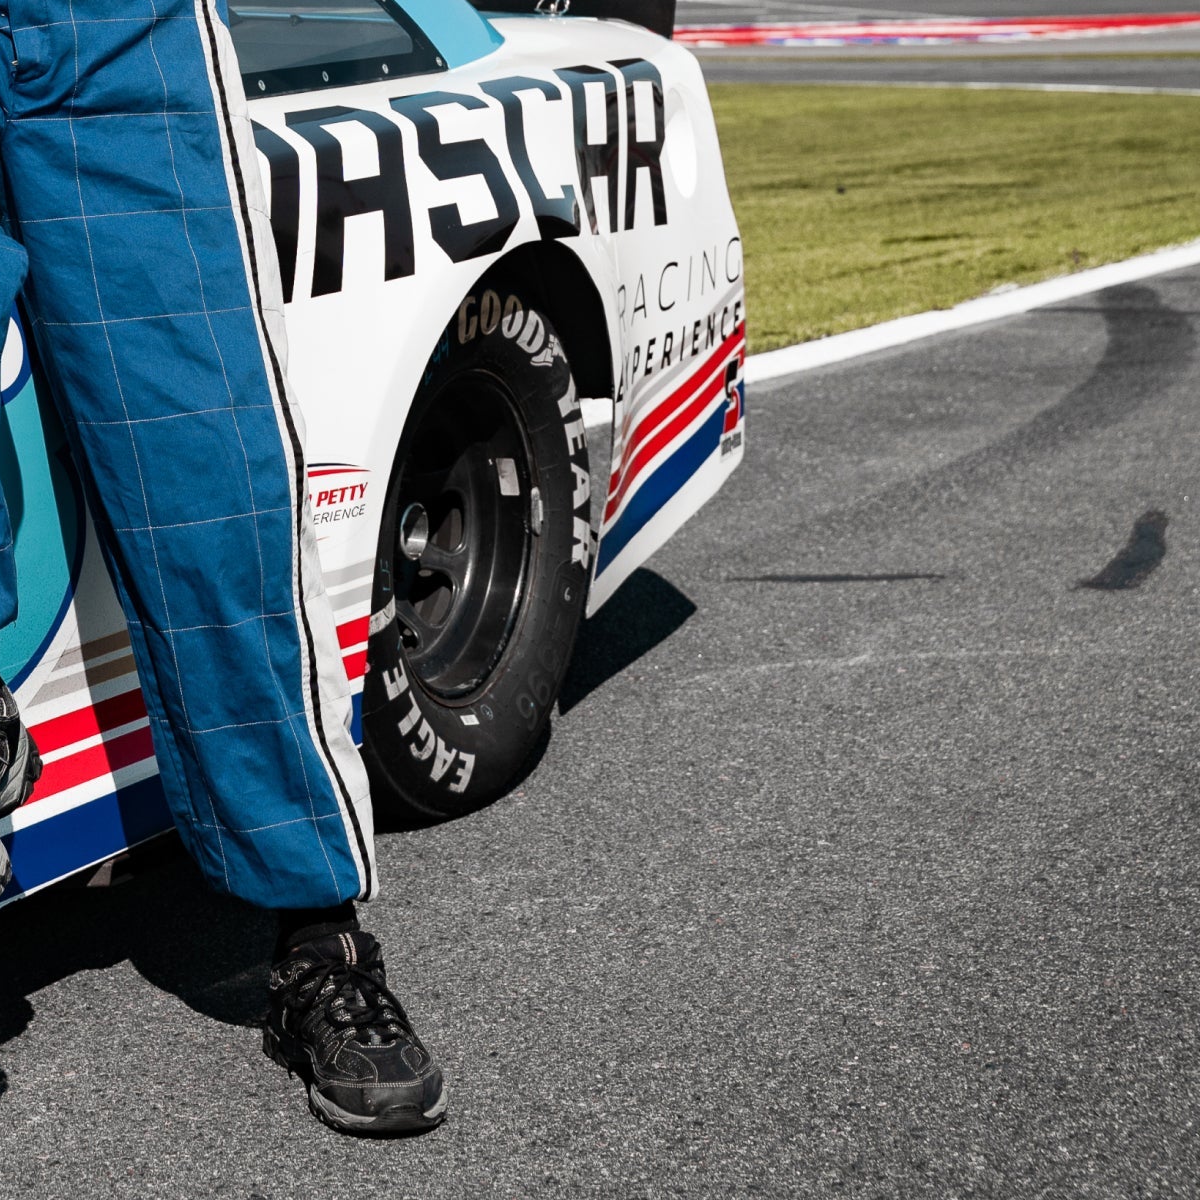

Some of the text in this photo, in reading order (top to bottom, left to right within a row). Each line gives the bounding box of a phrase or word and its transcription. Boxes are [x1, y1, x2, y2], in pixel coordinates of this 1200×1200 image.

[617, 237, 741, 332] RACING
[313, 504, 366, 525] ERIENCE
[316, 482, 368, 508] PETTY
[382, 658, 476, 793] EAGLE
